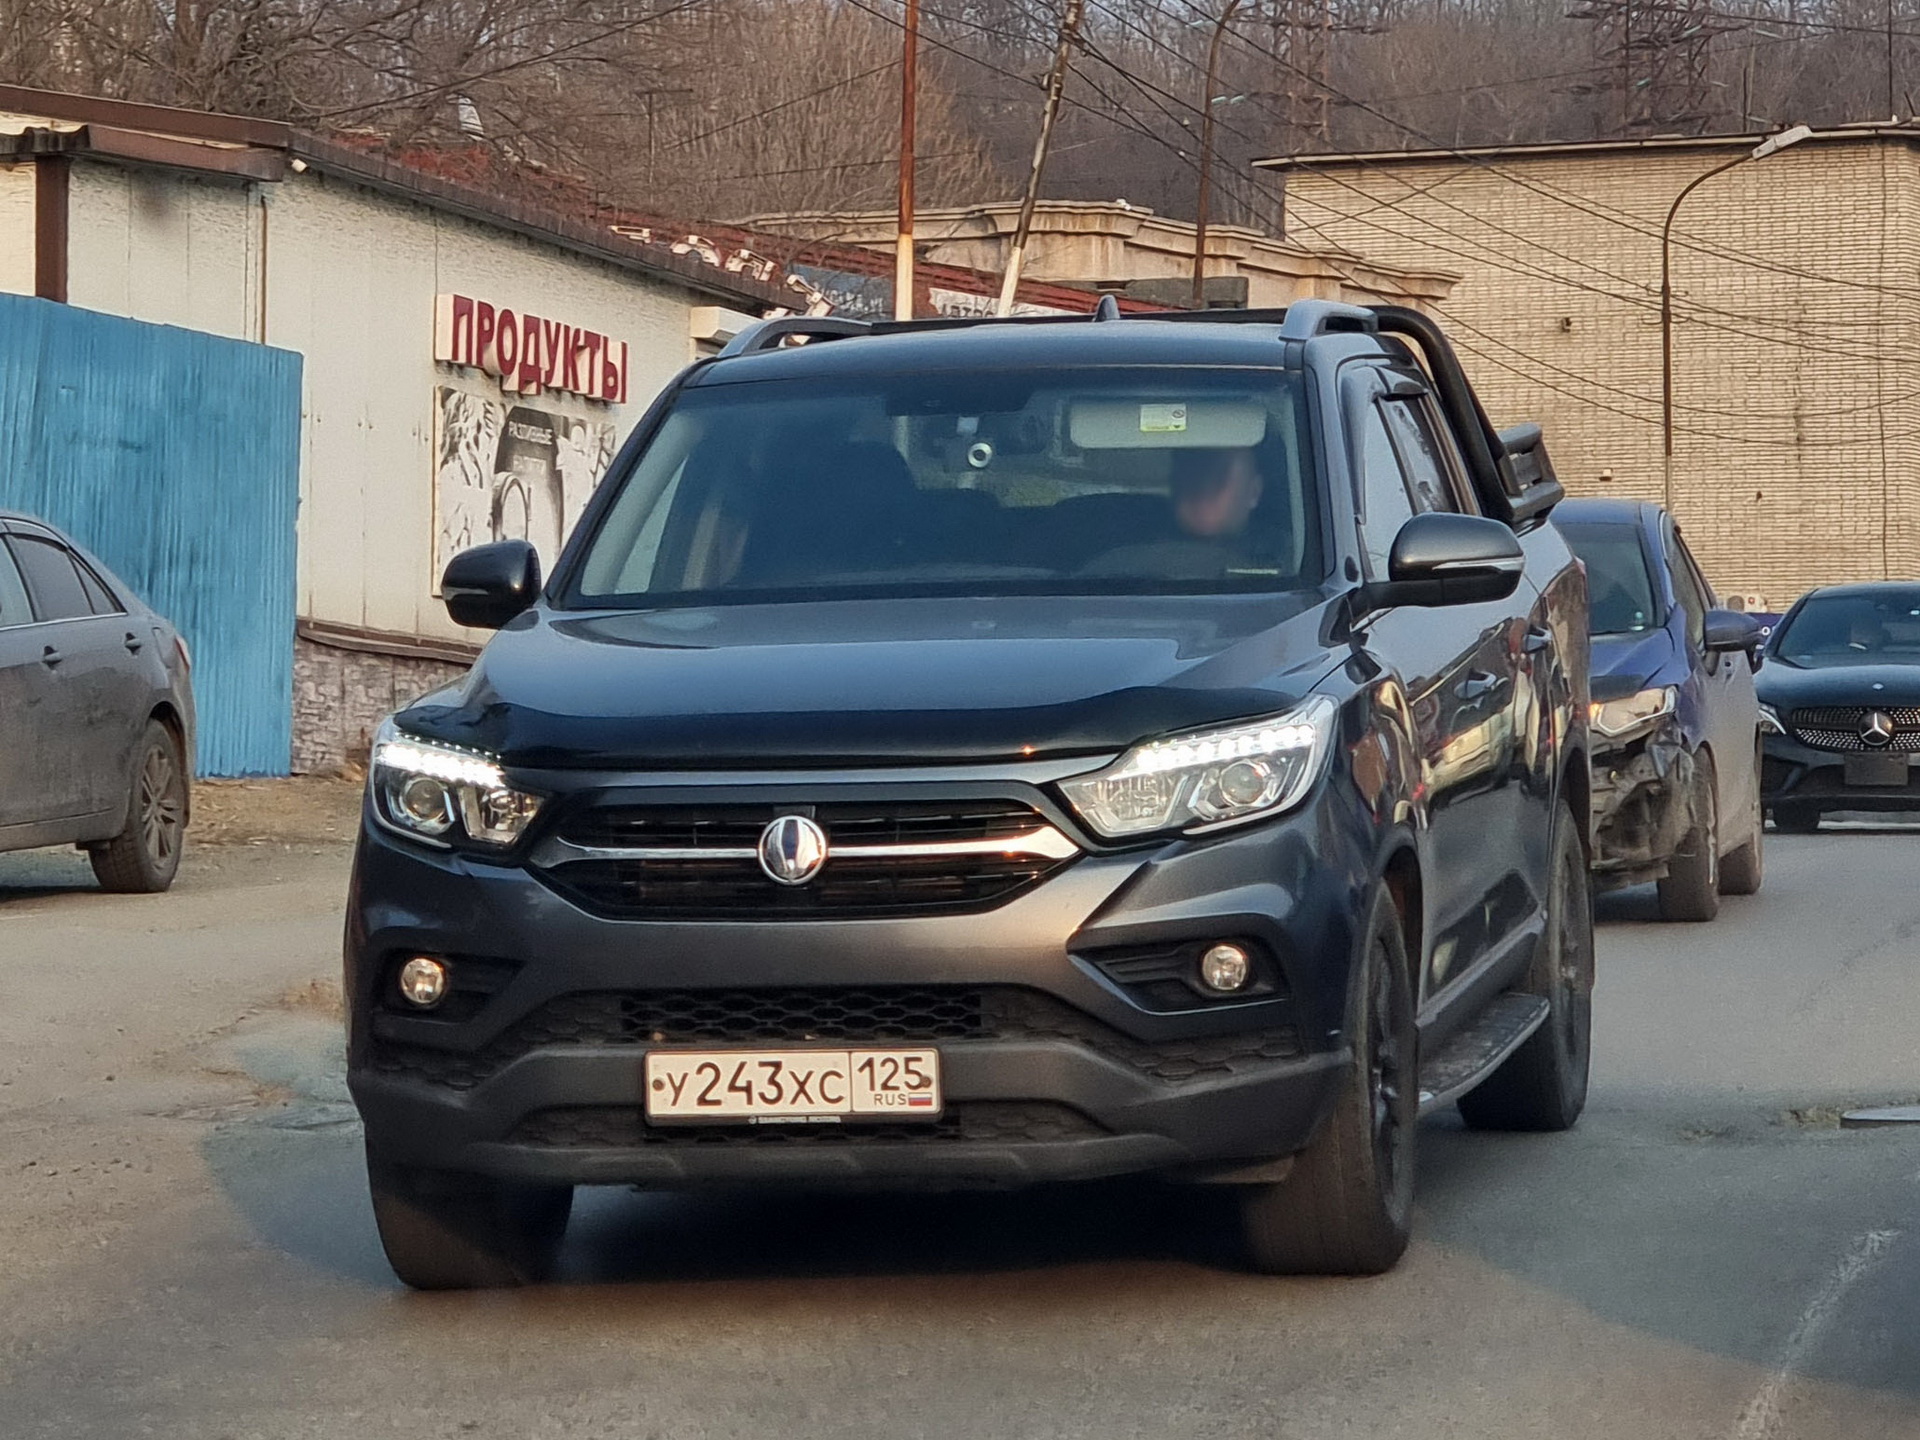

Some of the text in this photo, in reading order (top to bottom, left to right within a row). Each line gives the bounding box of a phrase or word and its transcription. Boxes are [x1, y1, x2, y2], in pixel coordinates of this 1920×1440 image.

[451, 294, 628, 404] ПРОДУКТЫ
[857, 1056, 925, 1092] 125
[873, 1093, 907, 1106] RUS
